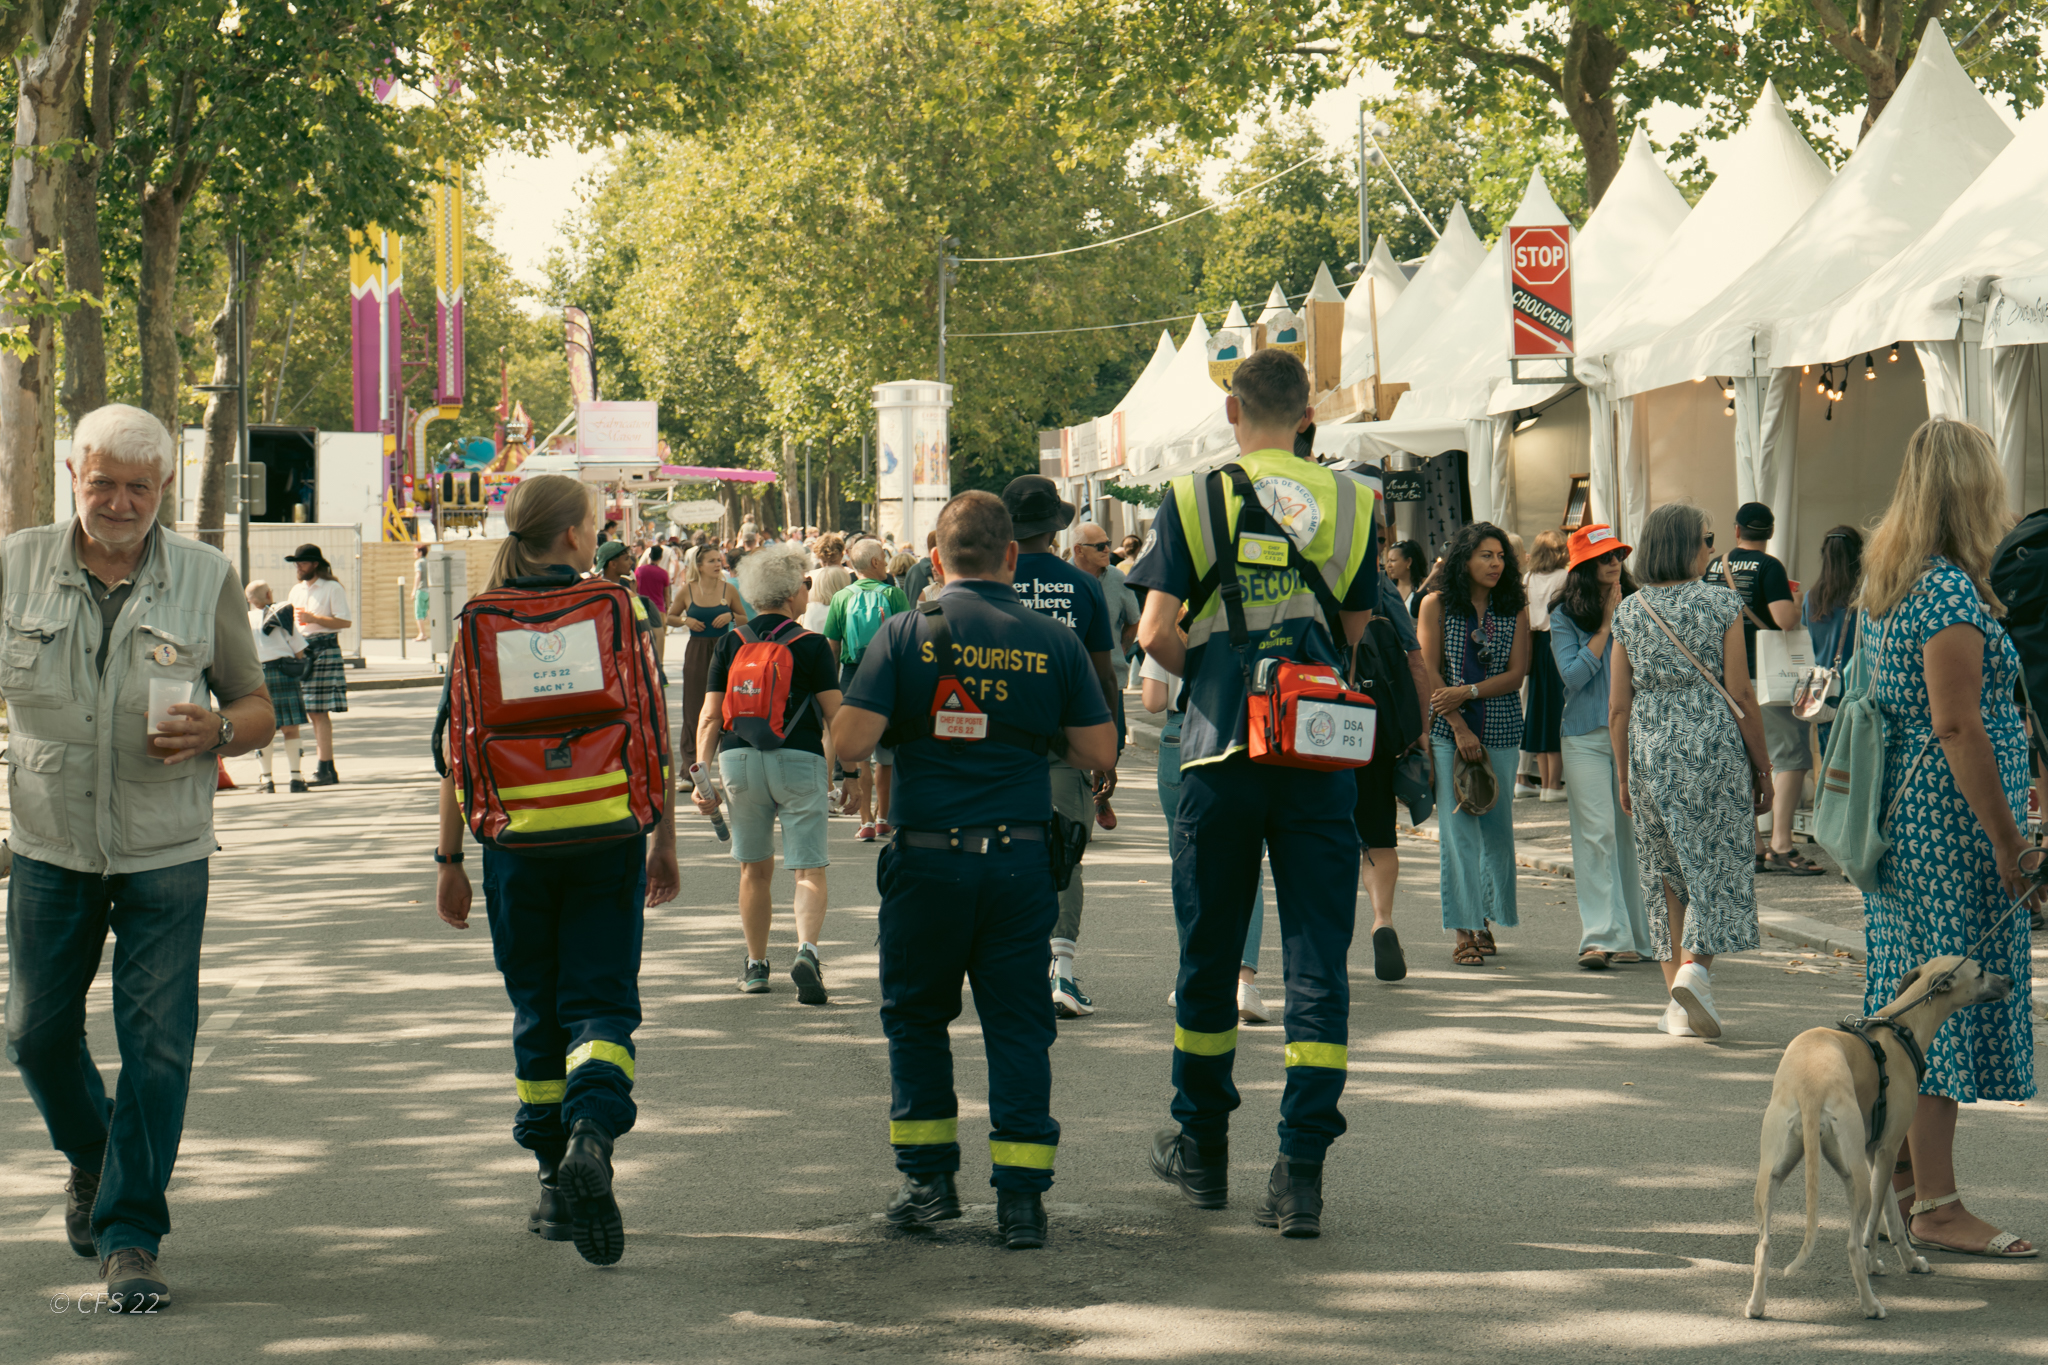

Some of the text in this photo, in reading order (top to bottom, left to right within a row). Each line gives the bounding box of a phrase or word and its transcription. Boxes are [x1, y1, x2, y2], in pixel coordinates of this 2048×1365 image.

[1516, 245, 1564, 268] STOP
[1512, 290, 1573, 334] CHOUCHEN
[1210, 361, 1242, 369] NOUGA
[1211, 369, 1233, 377] BRET
[586, 416, 651, 433] Fabrication
[596, 428, 642, 442] Maison
[1281, 480, 1292, 488] DE
[1294, 484, 1319, 534] SECOURISME
[1012, 578, 1075, 594] er been
[1020, 593, 1072, 610] where
[921, 641, 1049, 674] SCOURISTE
[533, 668, 571, 679] C.F.S 22
[1778, 669, 1799, 678] Arm
[533, 684, 553, 693] SAC
[940, 715, 983, 726] CHEF DE POSTE
[1344, 719, 1364, 732] DSA
[947, 725, 974, 735] CFS 22
[1342, 735, 1363, 748] PS 1
